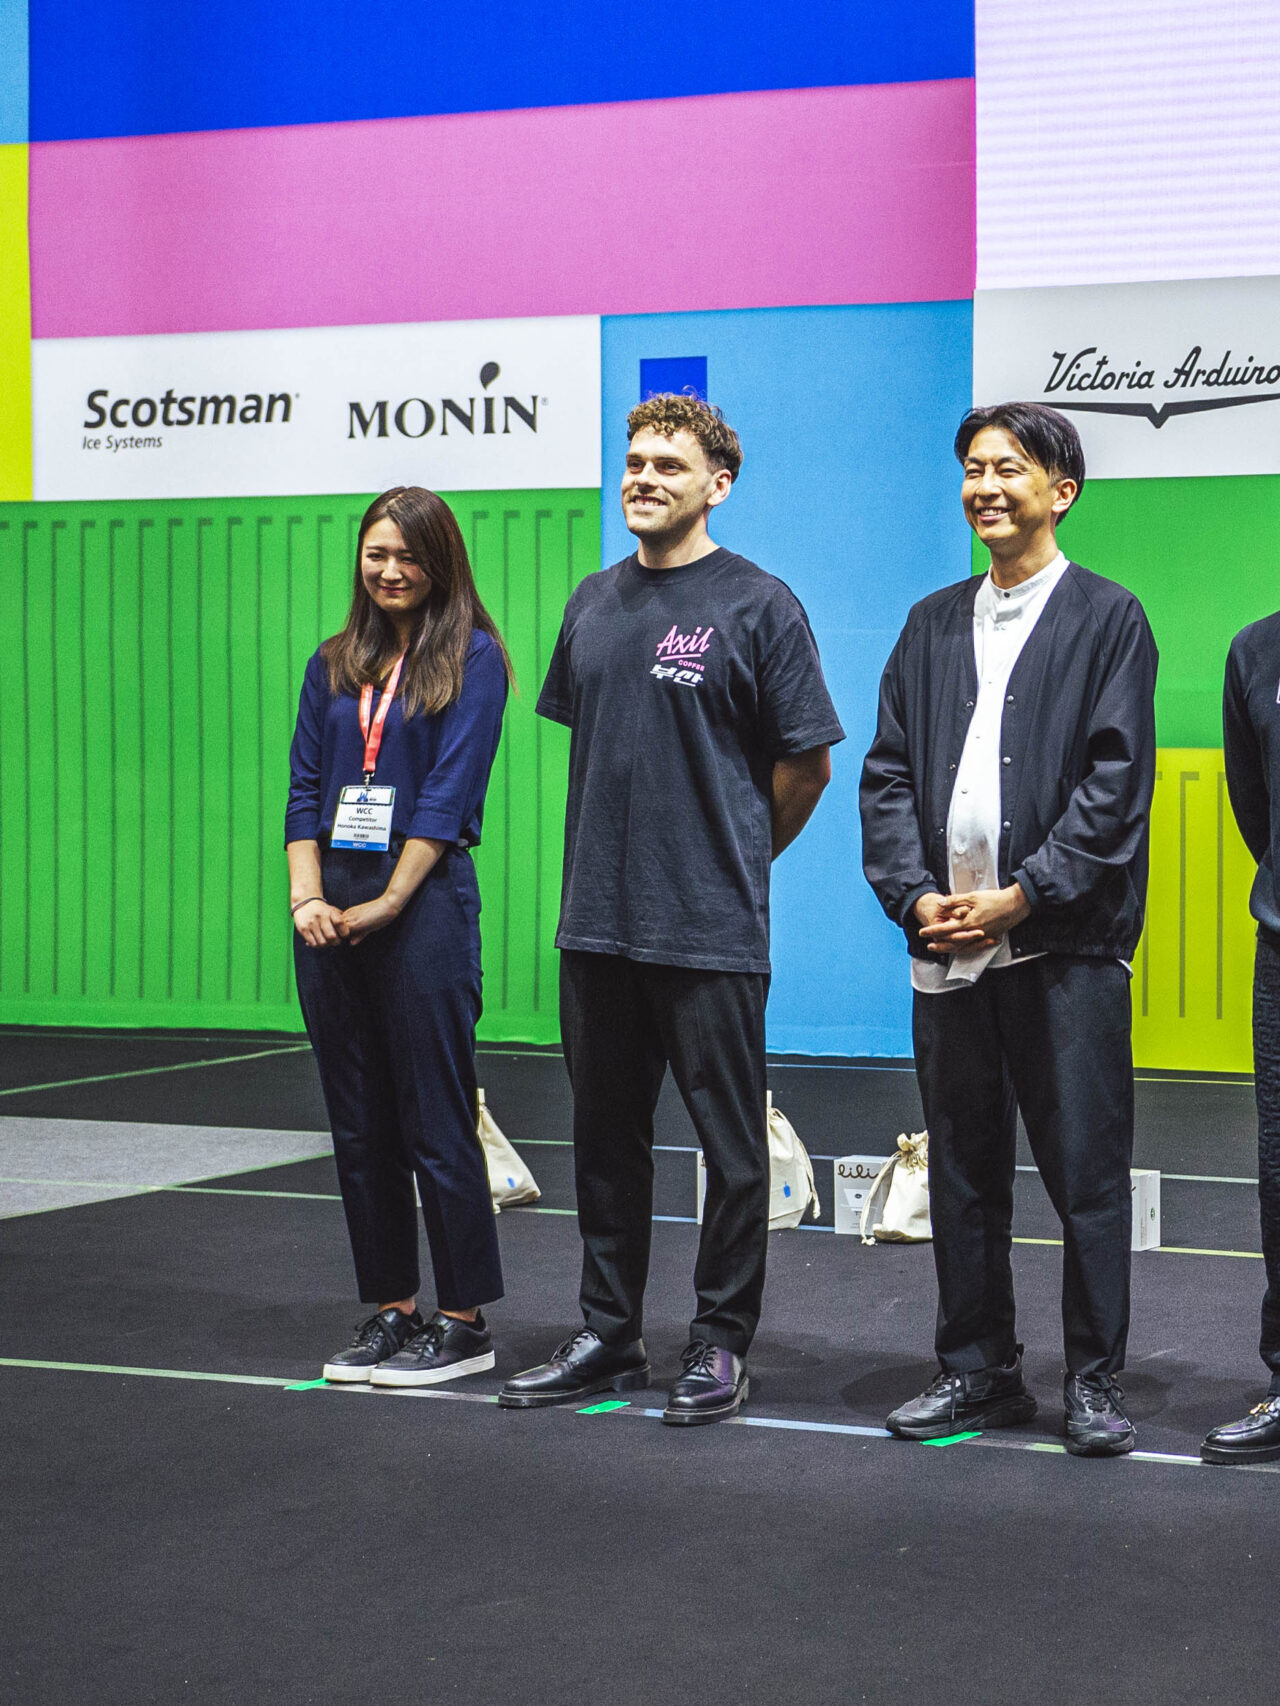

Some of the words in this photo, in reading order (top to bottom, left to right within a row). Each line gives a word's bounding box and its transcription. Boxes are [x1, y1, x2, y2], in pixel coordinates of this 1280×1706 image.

[1043, 346, 1155, 393] Victoria
[83, 388, 293, 429] Scotsman
[348, 361, 539, 439] MONIN
[82, 436, 102, 450] Ice
[105, 434, 163, 453] Systems
[656, 625, 714, 656] Axil
[678, 660, 705, 671] COFFEE
[356, 807, 373, 815] WCC
